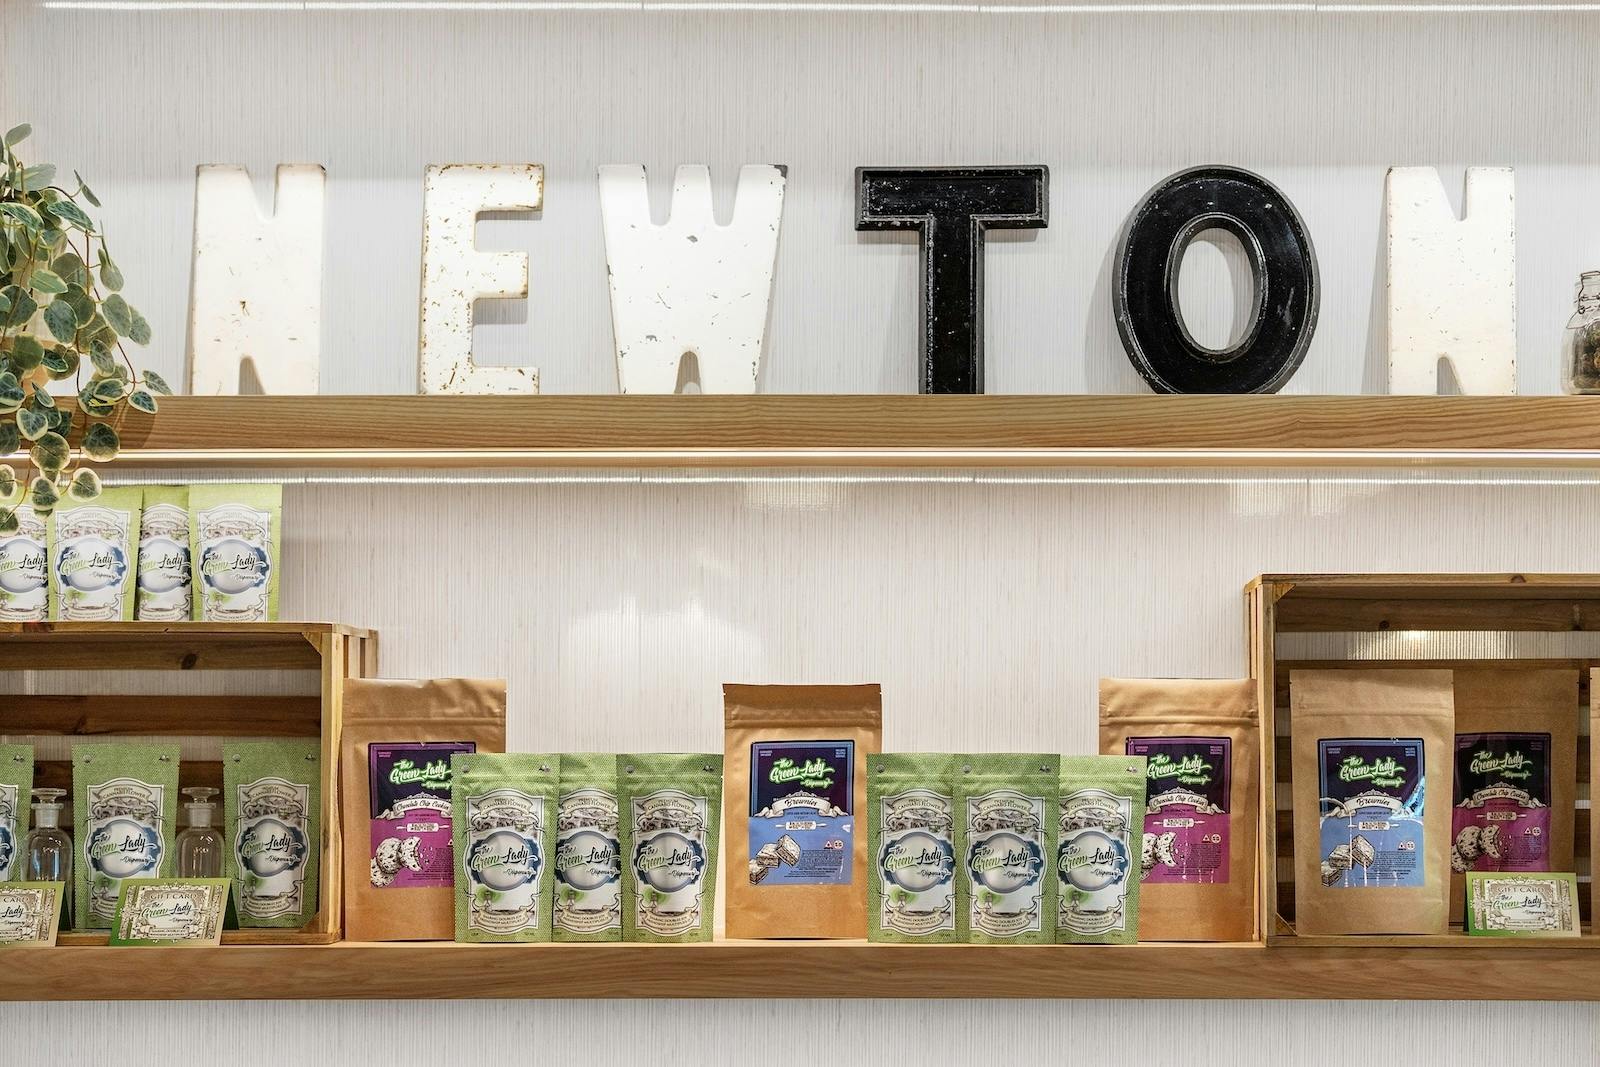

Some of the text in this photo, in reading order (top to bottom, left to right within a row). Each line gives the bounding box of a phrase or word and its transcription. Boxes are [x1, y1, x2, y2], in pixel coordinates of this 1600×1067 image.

[192, 163, 1516, 396] NEWTON
[19, 553, 46, 571] Lady
[60, 552, 117, 575] Green Lady
[158, 553, 186, 570] Lady
[203, 553, 259, 576] Green Lady
[390, 760, 449, 784] Green Lady
[769, 758, 830, 784] Green Lady
[1147, 754, 1207, 779] Green Lady
[1340, 757, 1401, 781] Green Lady
[1470, 751, 1528, 774] Green Lady
[92, 834, 150, 859] Green Lady
[266, 833, 295, 852] Lady
[472, 854, 502, 871] Green
[502, 845, 532, 865] Lady
[556, 846, 616, 871] Green Lady
[638, 846, 697, 871] Green Lady
[884, 847, 947, 871] Green Lady
[971, 847, 1033, 872] Green Lady
[1058, 847, 1120, 872] Green Lady
[1, 905, 24, 918] Lady
[142, 902, 192, 919] Green Lady
[1493, 895, 1542, 910] Green Lady
